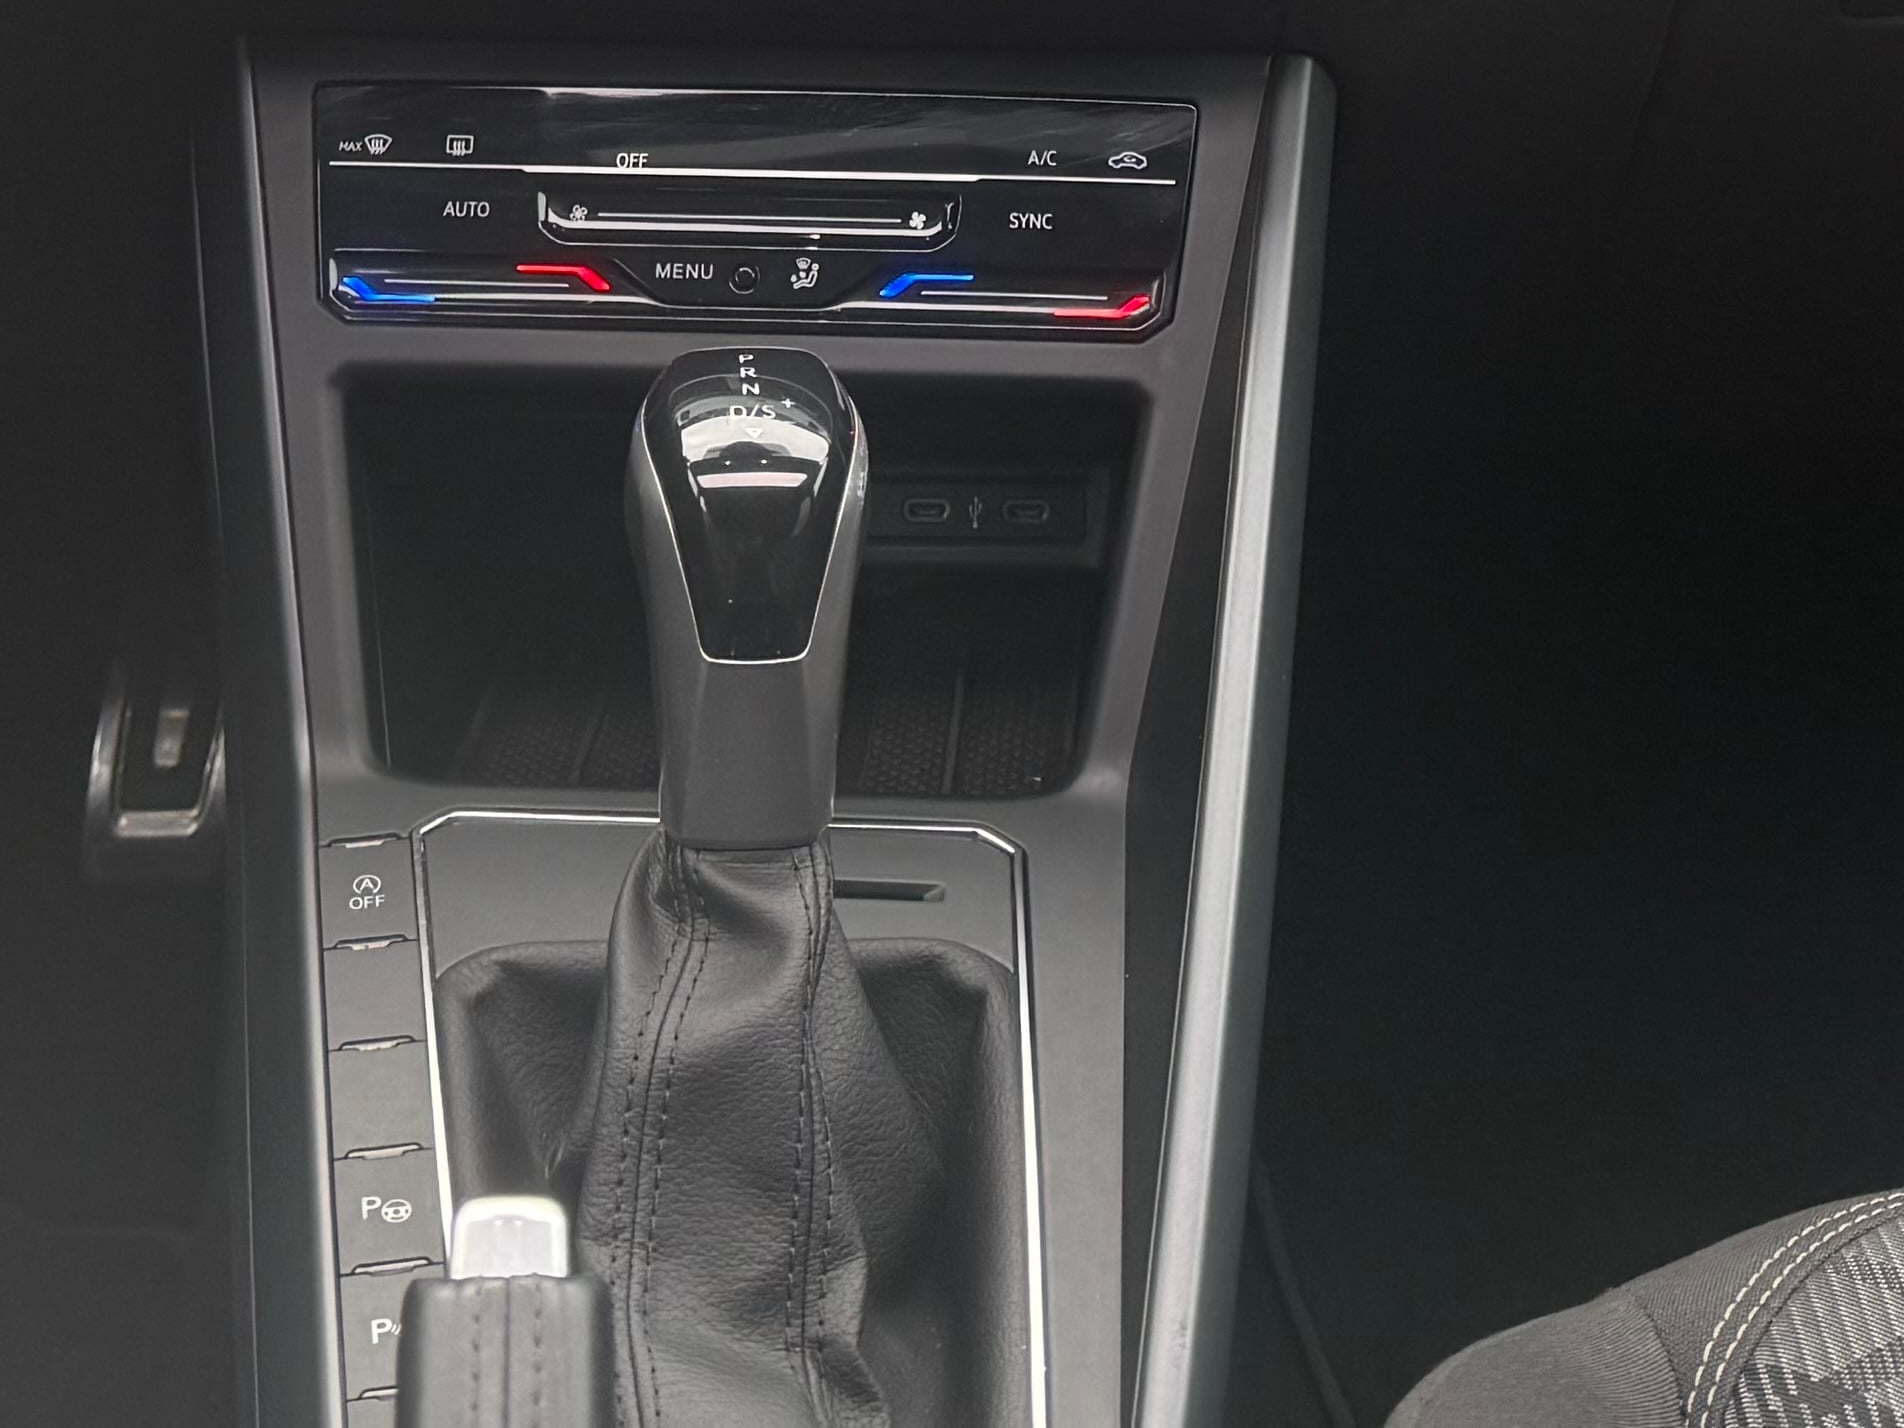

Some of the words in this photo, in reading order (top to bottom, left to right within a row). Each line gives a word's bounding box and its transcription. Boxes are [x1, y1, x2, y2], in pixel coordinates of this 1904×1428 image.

[338, 141, 364, 152] MAX
[615, 152, 649, 171] OFF
[1026, 150, 1058, 168] A/C
[443, 200, 490, 218] AUTO
[1008, 211, 1053, 232] SYNC
[655, 261, 714, 282] MENU
[738, 354, 755, 364] P
[739, 366, 758, 379] R
[741, 382, 761, 396] N
[349, 894, 385, 910] OFF
